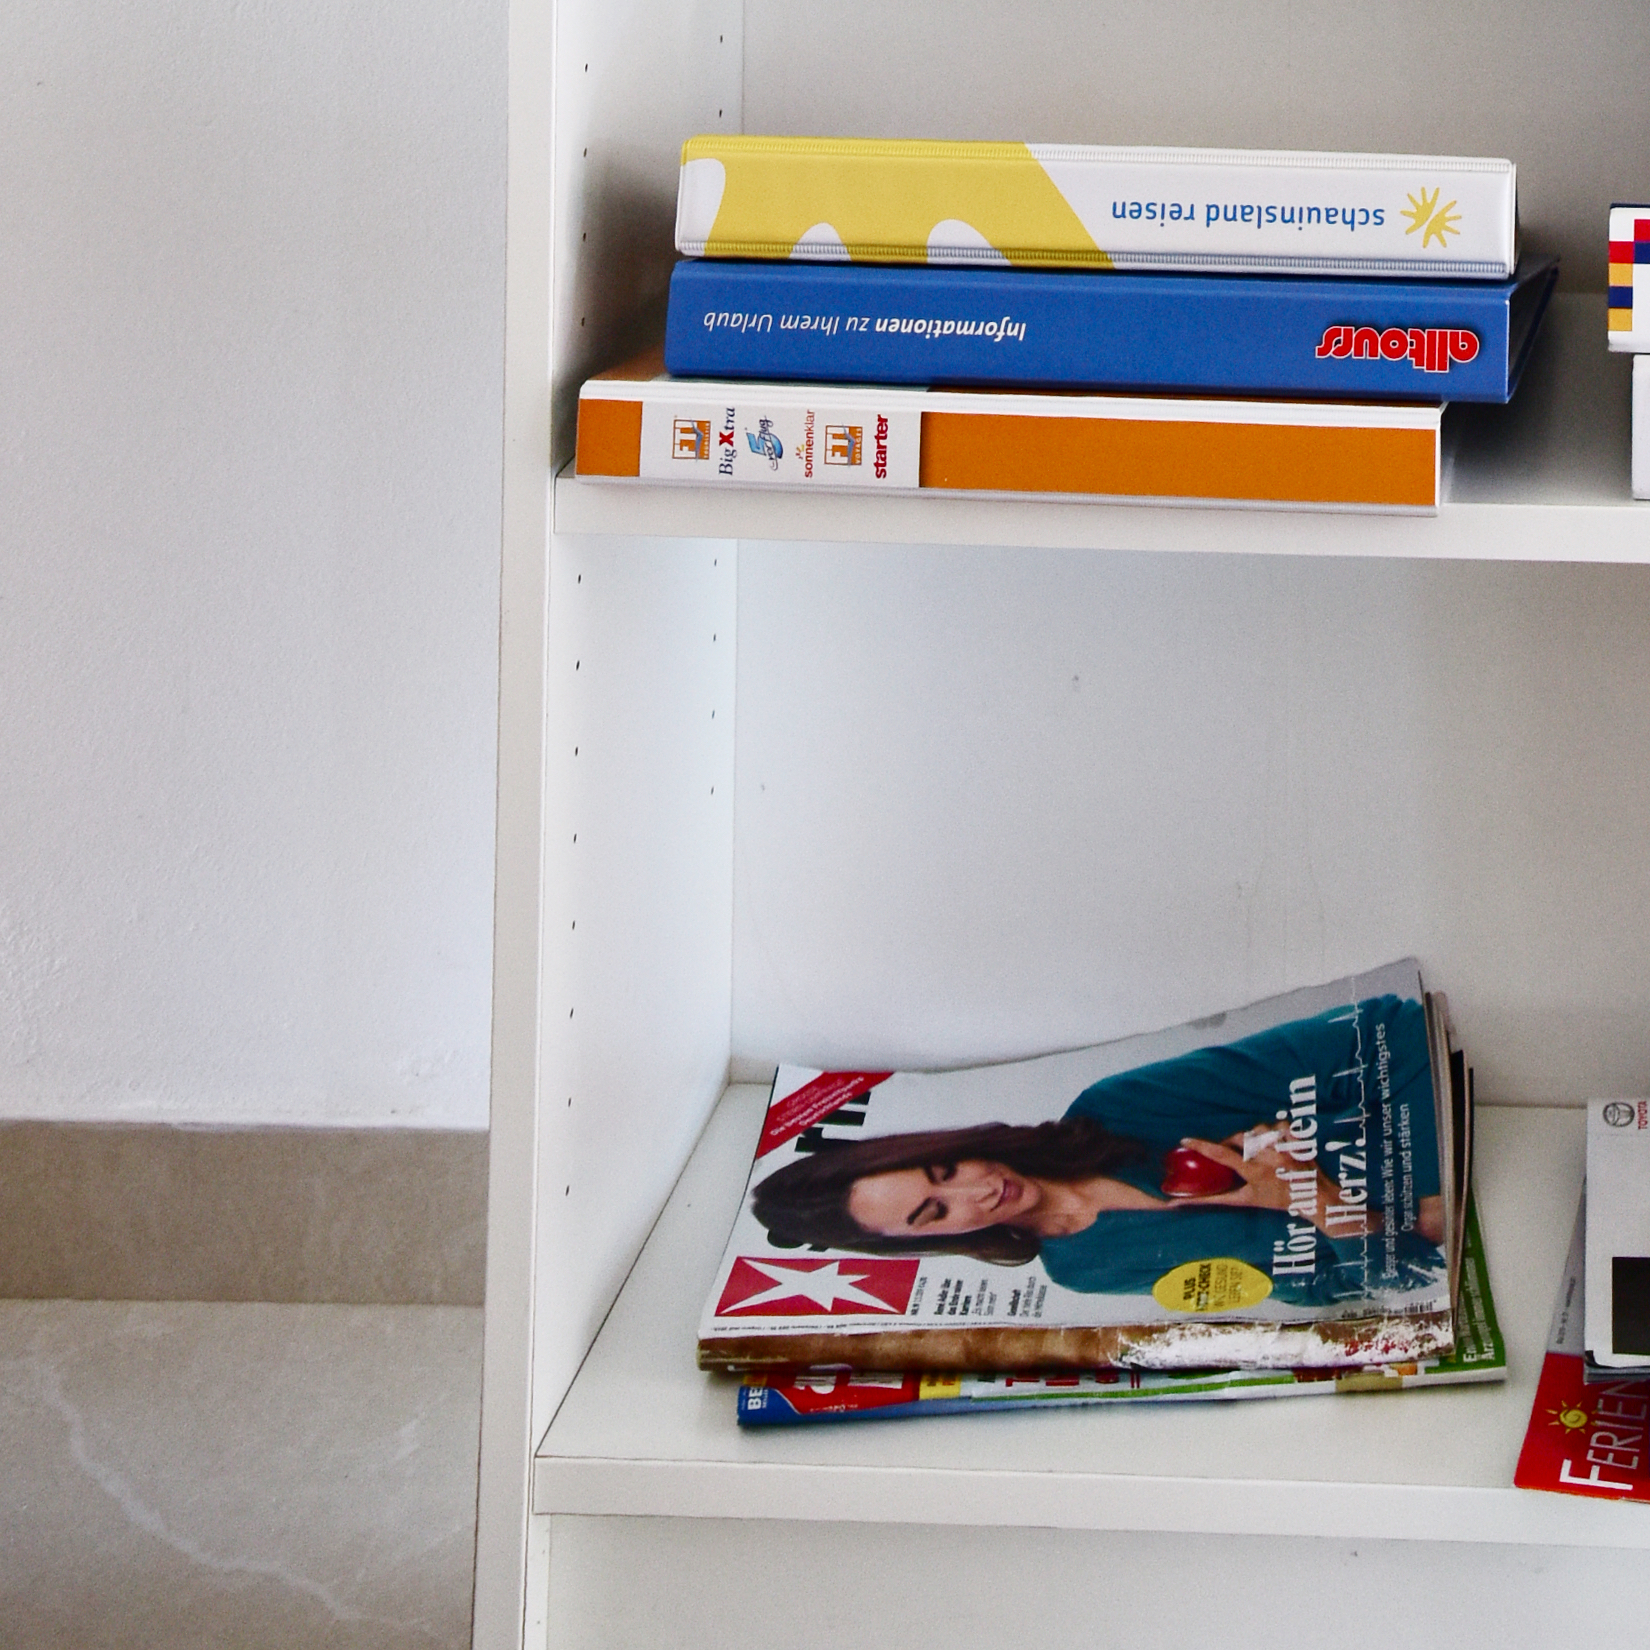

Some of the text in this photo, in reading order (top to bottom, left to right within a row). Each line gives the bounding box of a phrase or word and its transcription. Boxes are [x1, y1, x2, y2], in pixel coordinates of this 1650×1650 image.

[1111, 200, 1385, 232] schauinsland reisen
[704, 311, 1027, 343] Informationen zu Ihrem Urlaub
[1315, 325, 1480, 373] alltours
[874, 414, 889, 479] starter
[1376, 1023, 1390, 1098] wichtigstes
[1382, 1103, 1392, 1136] unser
[1272, 1074, 1317, 1276] Hör auf dein
[1325, 1139, 1368, 1228] Herz!
